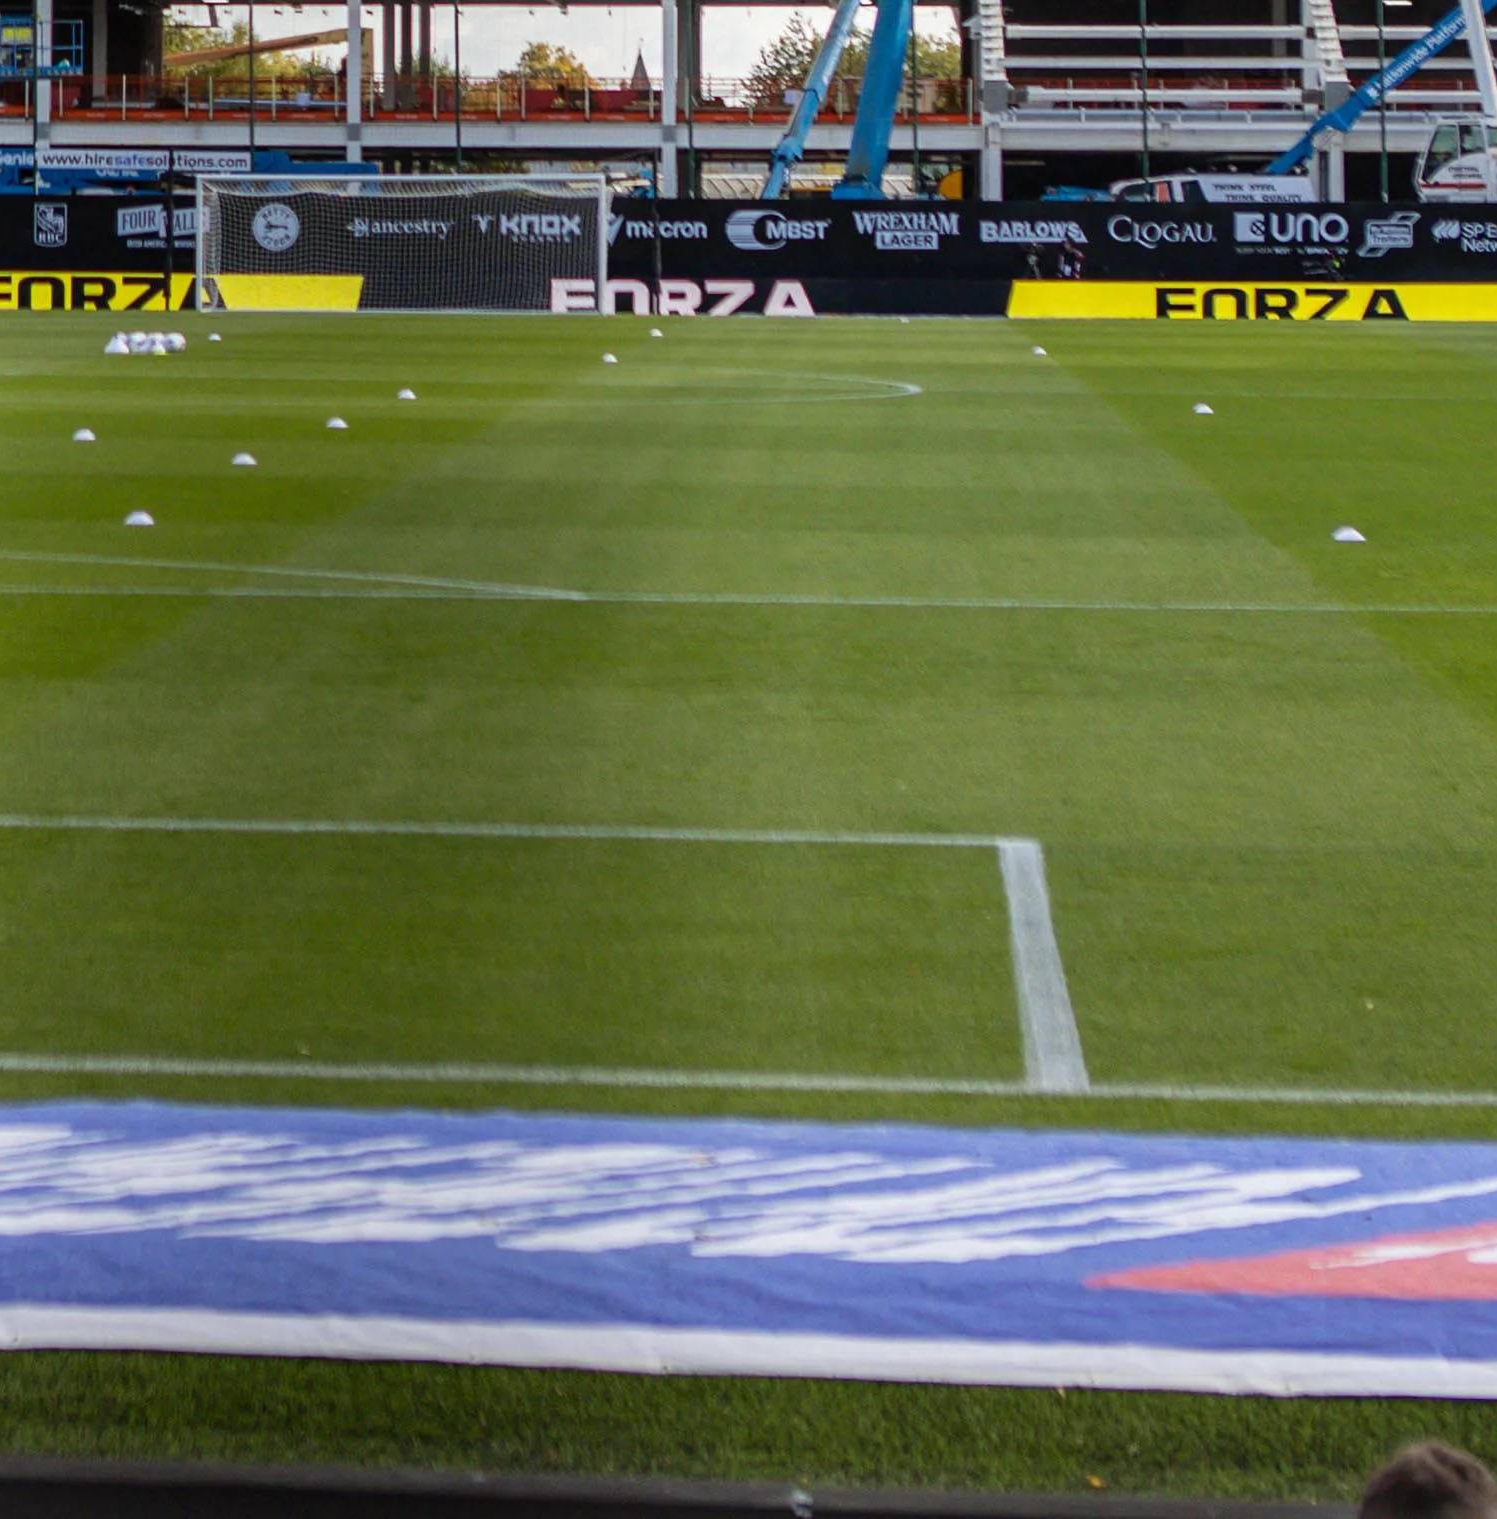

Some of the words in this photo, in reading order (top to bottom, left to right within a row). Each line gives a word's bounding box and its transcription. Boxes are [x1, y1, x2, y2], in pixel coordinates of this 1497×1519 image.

[121, 210, 156, 230] FOUR
[371, 218, 450, 240] ancestry
[499, 213, 581, 236] KNOX
[766, 220, 828, 240] MBST
[852, 211, 960, 236] WREXHAM
[980, 220, 1082, 241] BARLOWS
[880, 234, 935, 247] LAGER
[1462, 223, 1485, 239] SP
[550, 278, 816, 317] FORZA
[1156, 287, 1411, 321] FORZA
